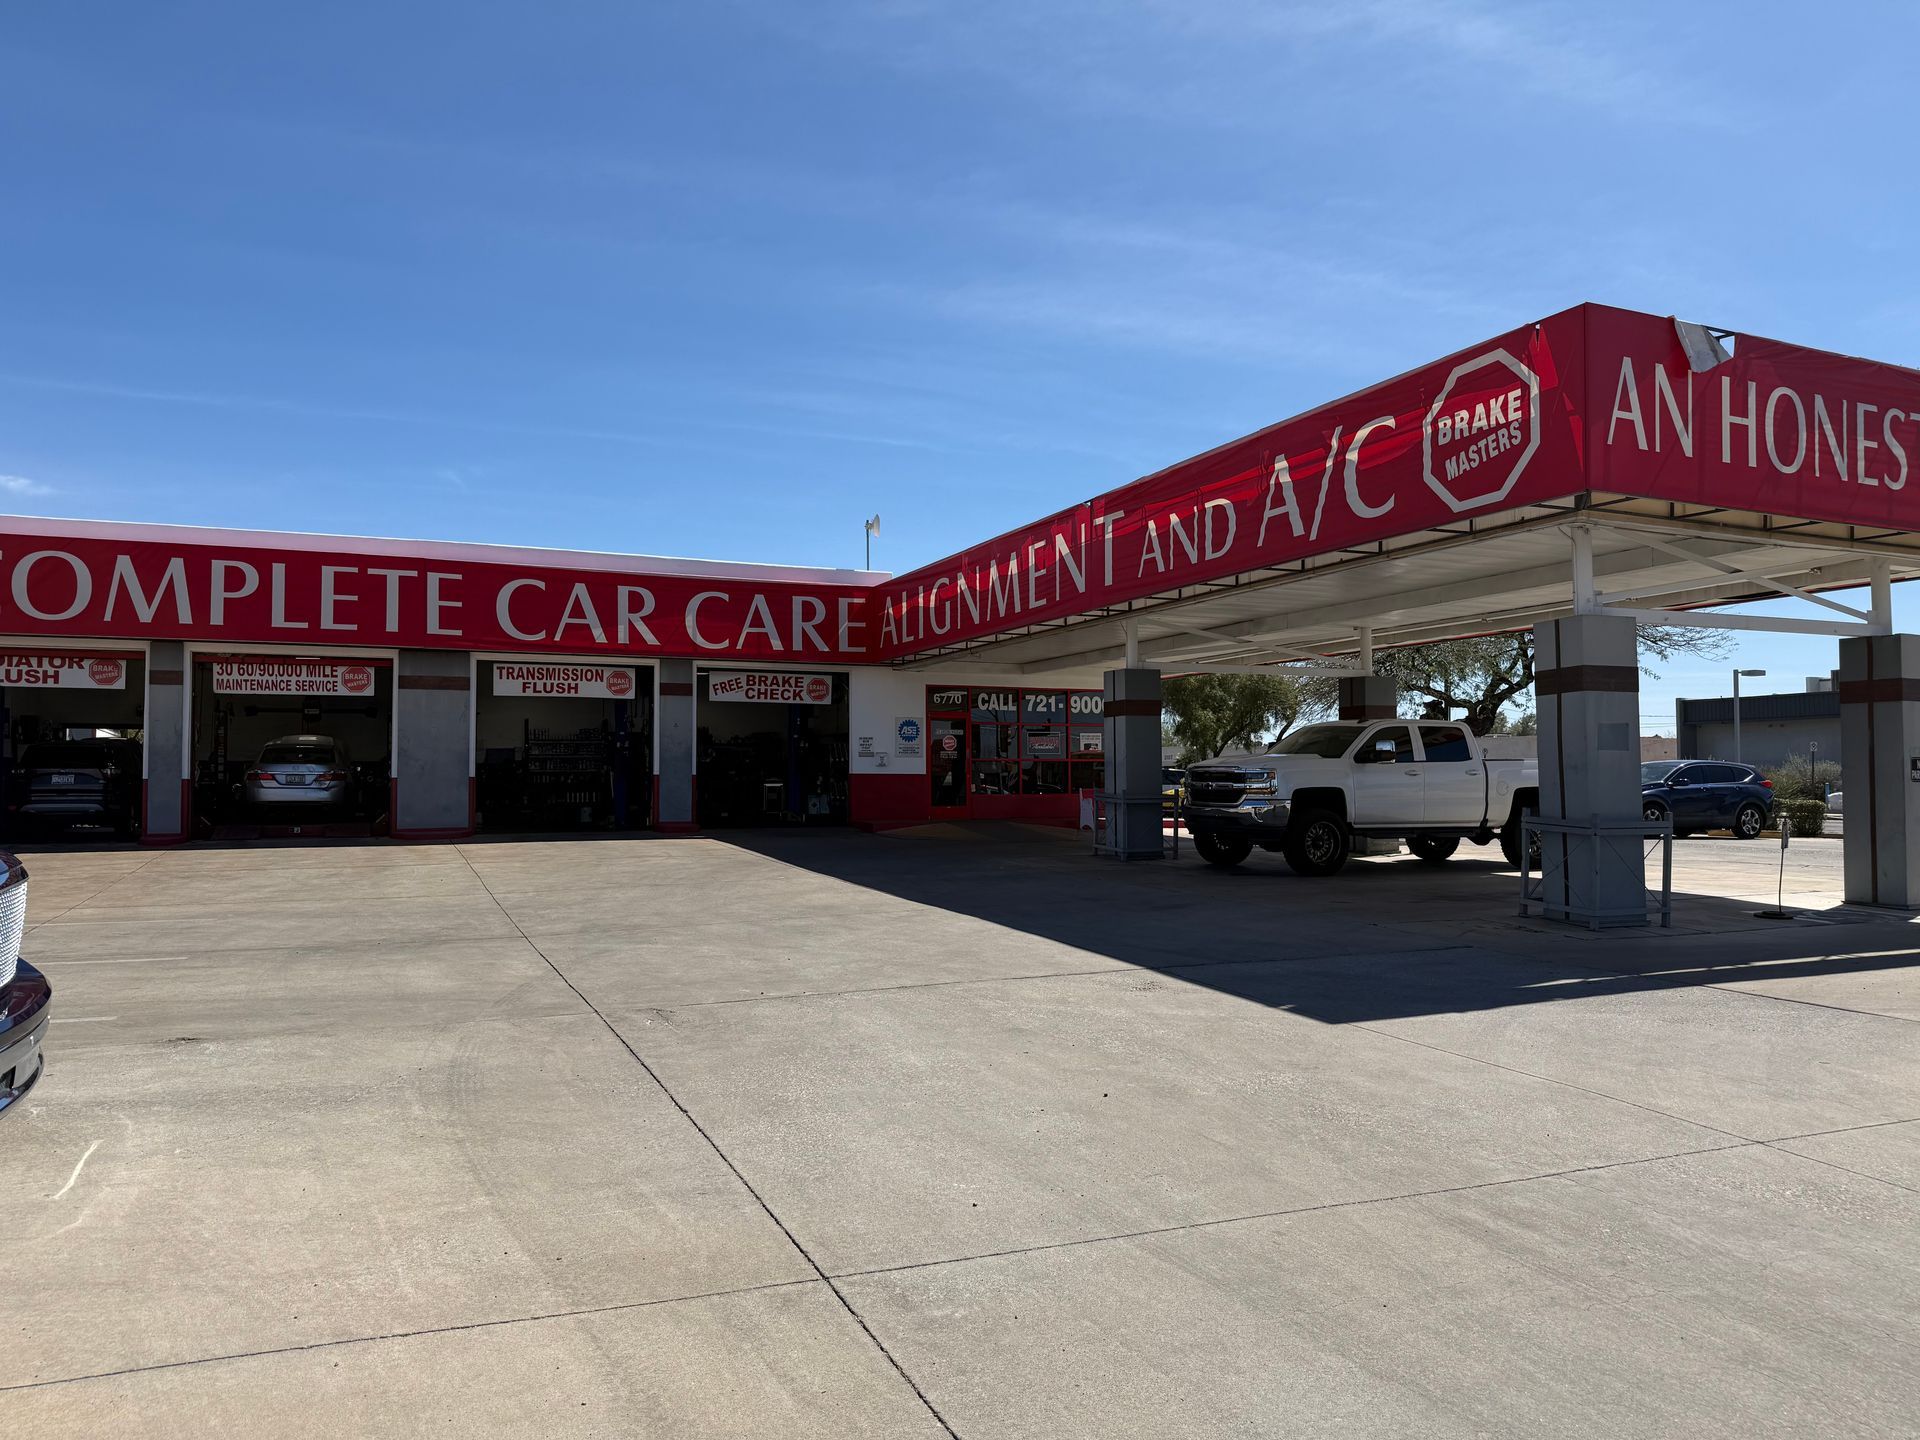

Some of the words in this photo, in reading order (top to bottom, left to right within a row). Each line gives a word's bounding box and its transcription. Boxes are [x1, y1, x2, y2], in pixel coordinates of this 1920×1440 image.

[1438, 388, 1522, 446] BRAKE
[1607, 356, 1694, 458] AN
[1721, 375, 1920, 490] HONES
[1445, 420, 1522, 481] MASTERS
[880, 510, 1125, 648] ALIGNMENT
[1138, 498, 1237, 578] AND
[1257, 415, 1396, 547] A/C
[0, 550, 463, 636] OMPLETE
[496, 578, 661, 646] CAR
[685, 591, 867, 653] CARE
[0, 656, 85, 669] IATOR
[0, 669, 60, 685] USH
[306, 665, 338, 678] MILE
[496, 666, 604, 682] TRANSMISSION
[216, 678, 291, 691] MAINTENANCE
[295, 680, 338, 692] SERVICE
[522, 682, 579, 694] FLUSH
[712, 677, 744, 696] FREE
[745, 674, 804, 688] BRAKE
[745, 687, 804, 701] CHECK
[933, 693, 962, 704] 6770
[977, 693, 1017, 711] CALL
[1070, 695, 1104, 714] 900
[900, 726, 917, 734] ASE
